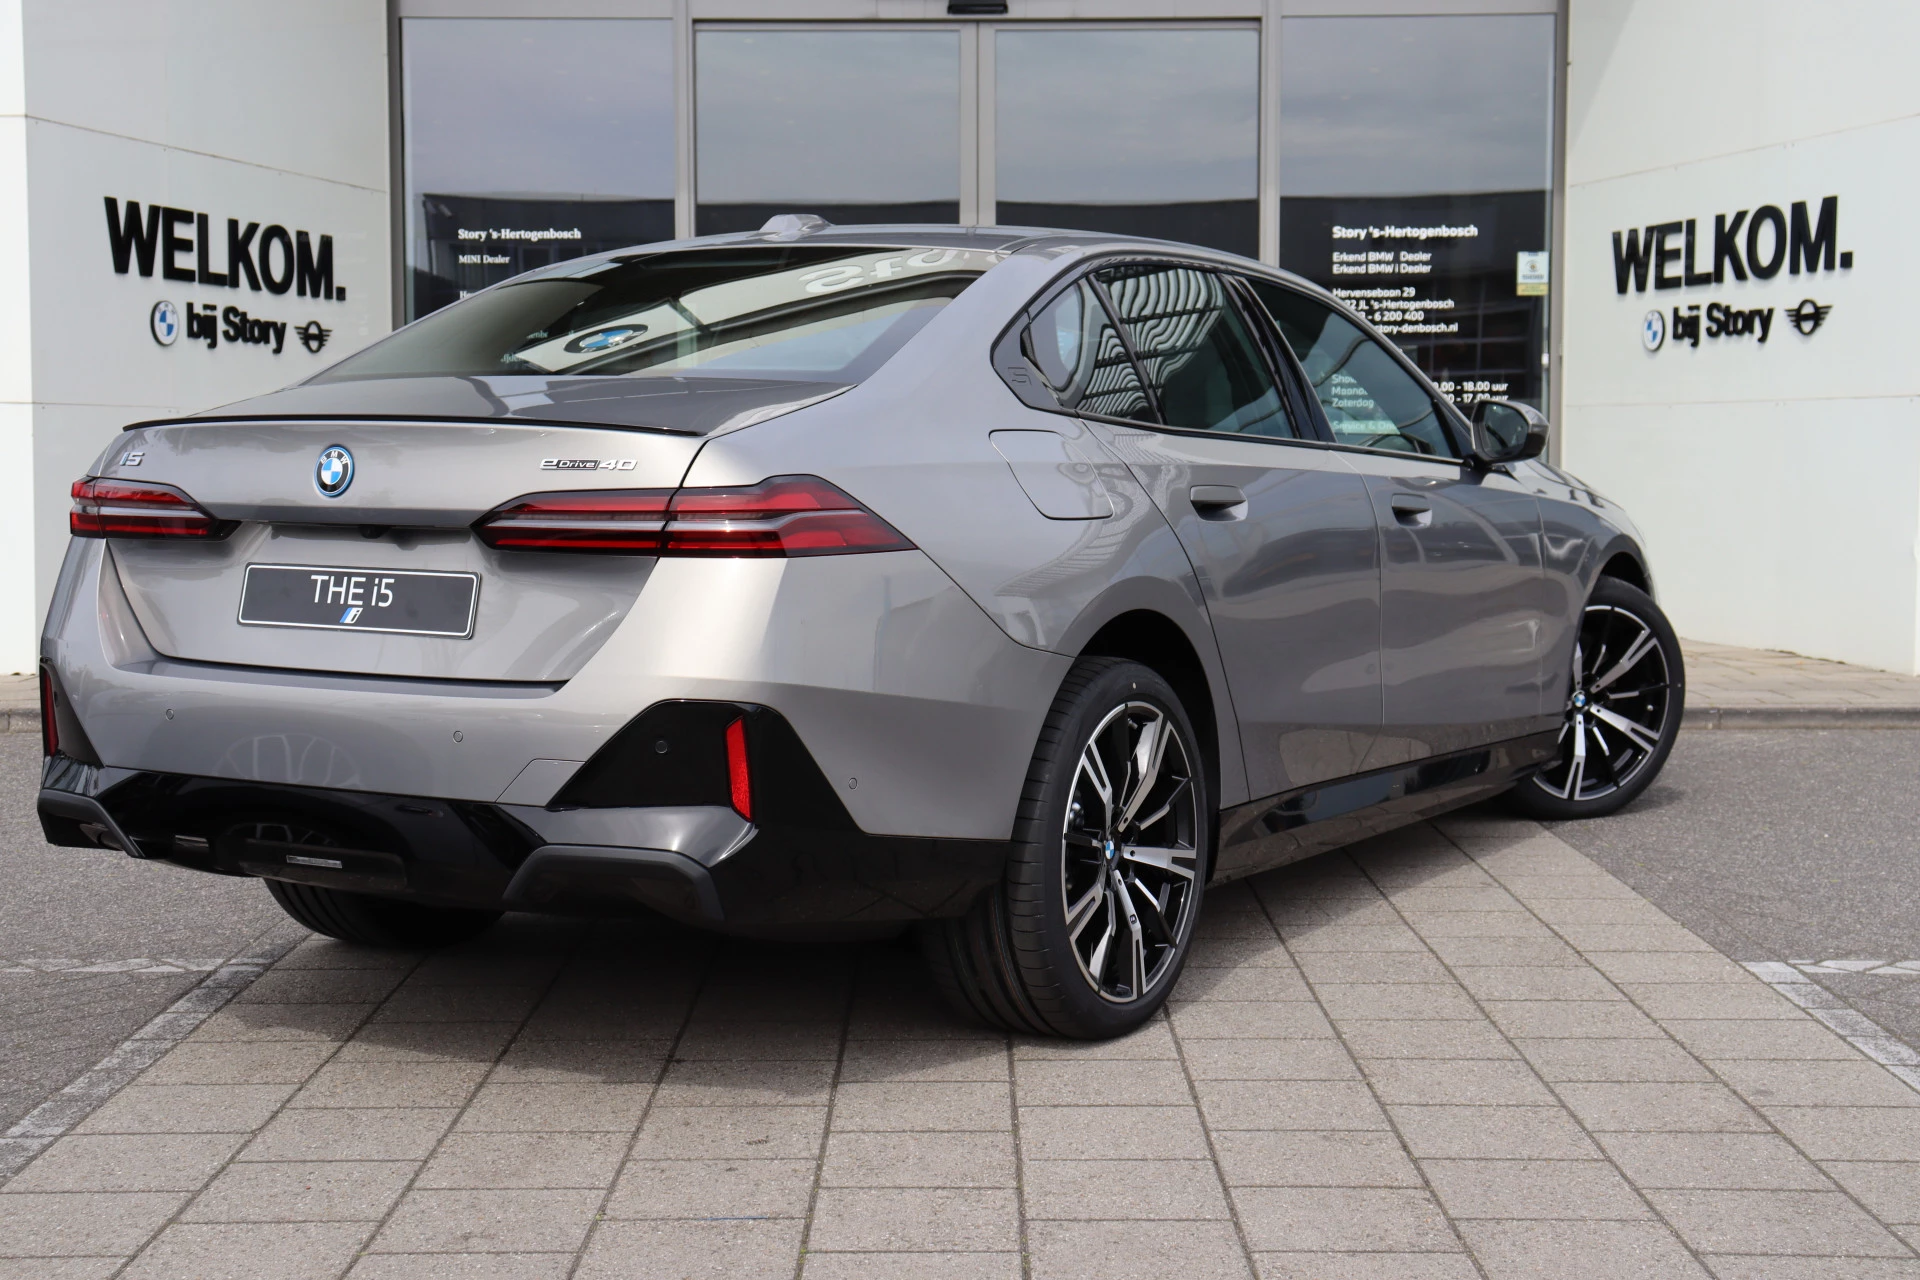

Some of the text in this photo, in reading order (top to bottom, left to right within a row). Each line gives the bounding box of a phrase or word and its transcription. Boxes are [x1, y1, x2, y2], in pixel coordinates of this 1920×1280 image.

[458, 228, 487, 242] Story
[1332, 225, 1367, 240] Story
[104, 196, 346, 301] WELKOM.
[1612, 195, 1853, 295] WELKOM.
[459, 254, 511, 264] MINI Dealer
[1332, 251, 1432, 262] Erkend BMW Dealer
[1332, 263, 1366, 274] Erkend
[1368, 263, 1394, 273] BMW
[1400, 263, 1432, 273] Dealer
[1332, 287, 1416, 298] Hervensebaan 29
[1374, 311, 1382, 321] 6
[1382, 311, 1403, 321] 200
[1404, 311, 1425, 321] 400
[1706, 302, 1775, 343] Story
[222, 306, 287, 354] Story
[1462, 381, 1490, 392] 18.00
[1491, 383, 1509, 392] uur
[320, 450, 349, 465] BMW
[311, 575, 395, 607] THE i5
